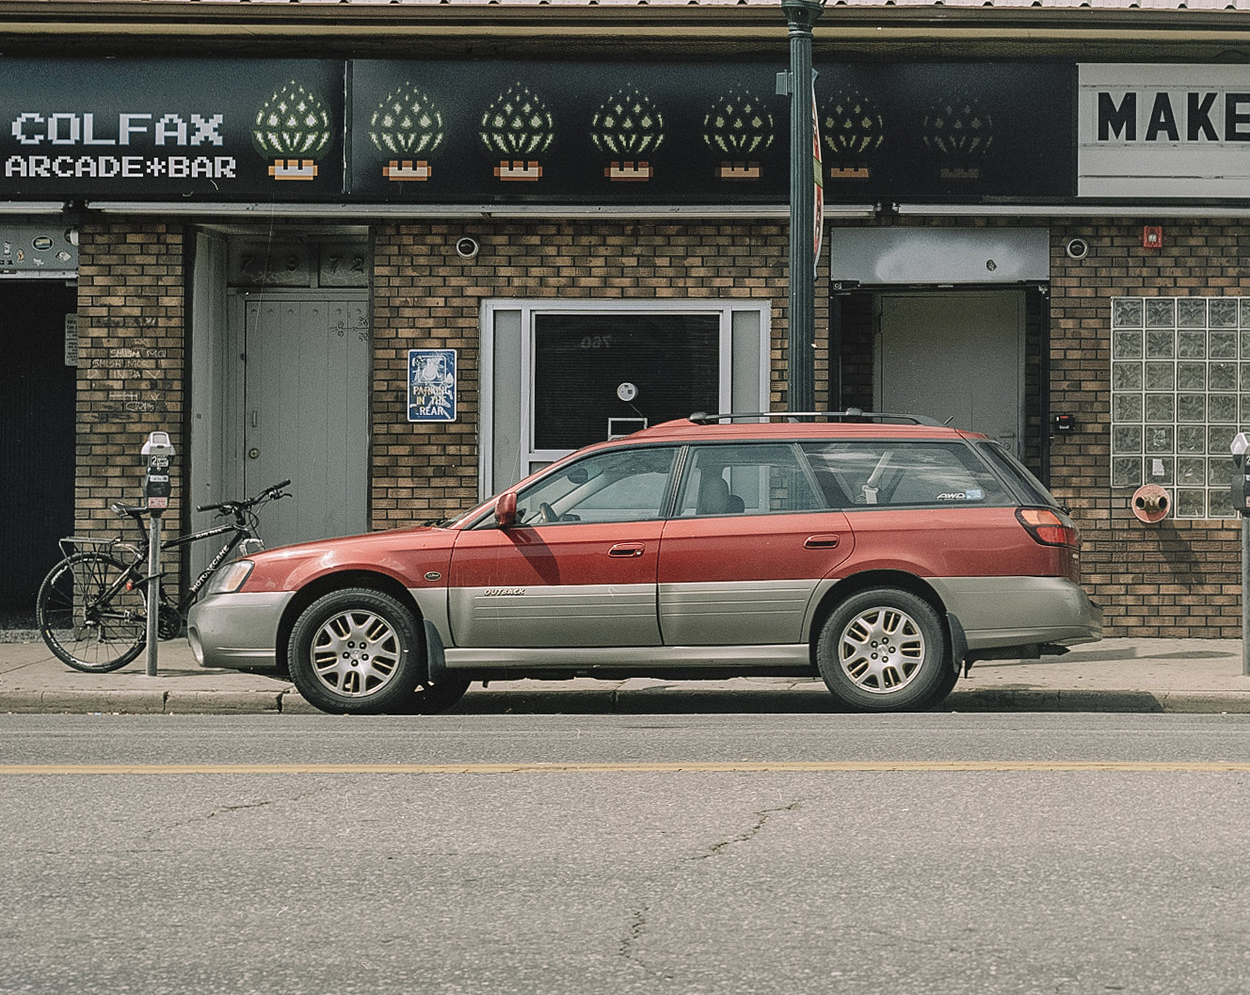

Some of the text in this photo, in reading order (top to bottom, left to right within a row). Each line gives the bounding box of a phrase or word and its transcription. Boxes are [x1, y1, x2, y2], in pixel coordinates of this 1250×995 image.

[11, 112, 224, 146] COLFAX
[413, 386, 450, 395] PARKING
[416, 396, 446, 405] IN THE
[420, 407, 443, 415] REAR
[484, 588, 526, 596] OUTBACK
